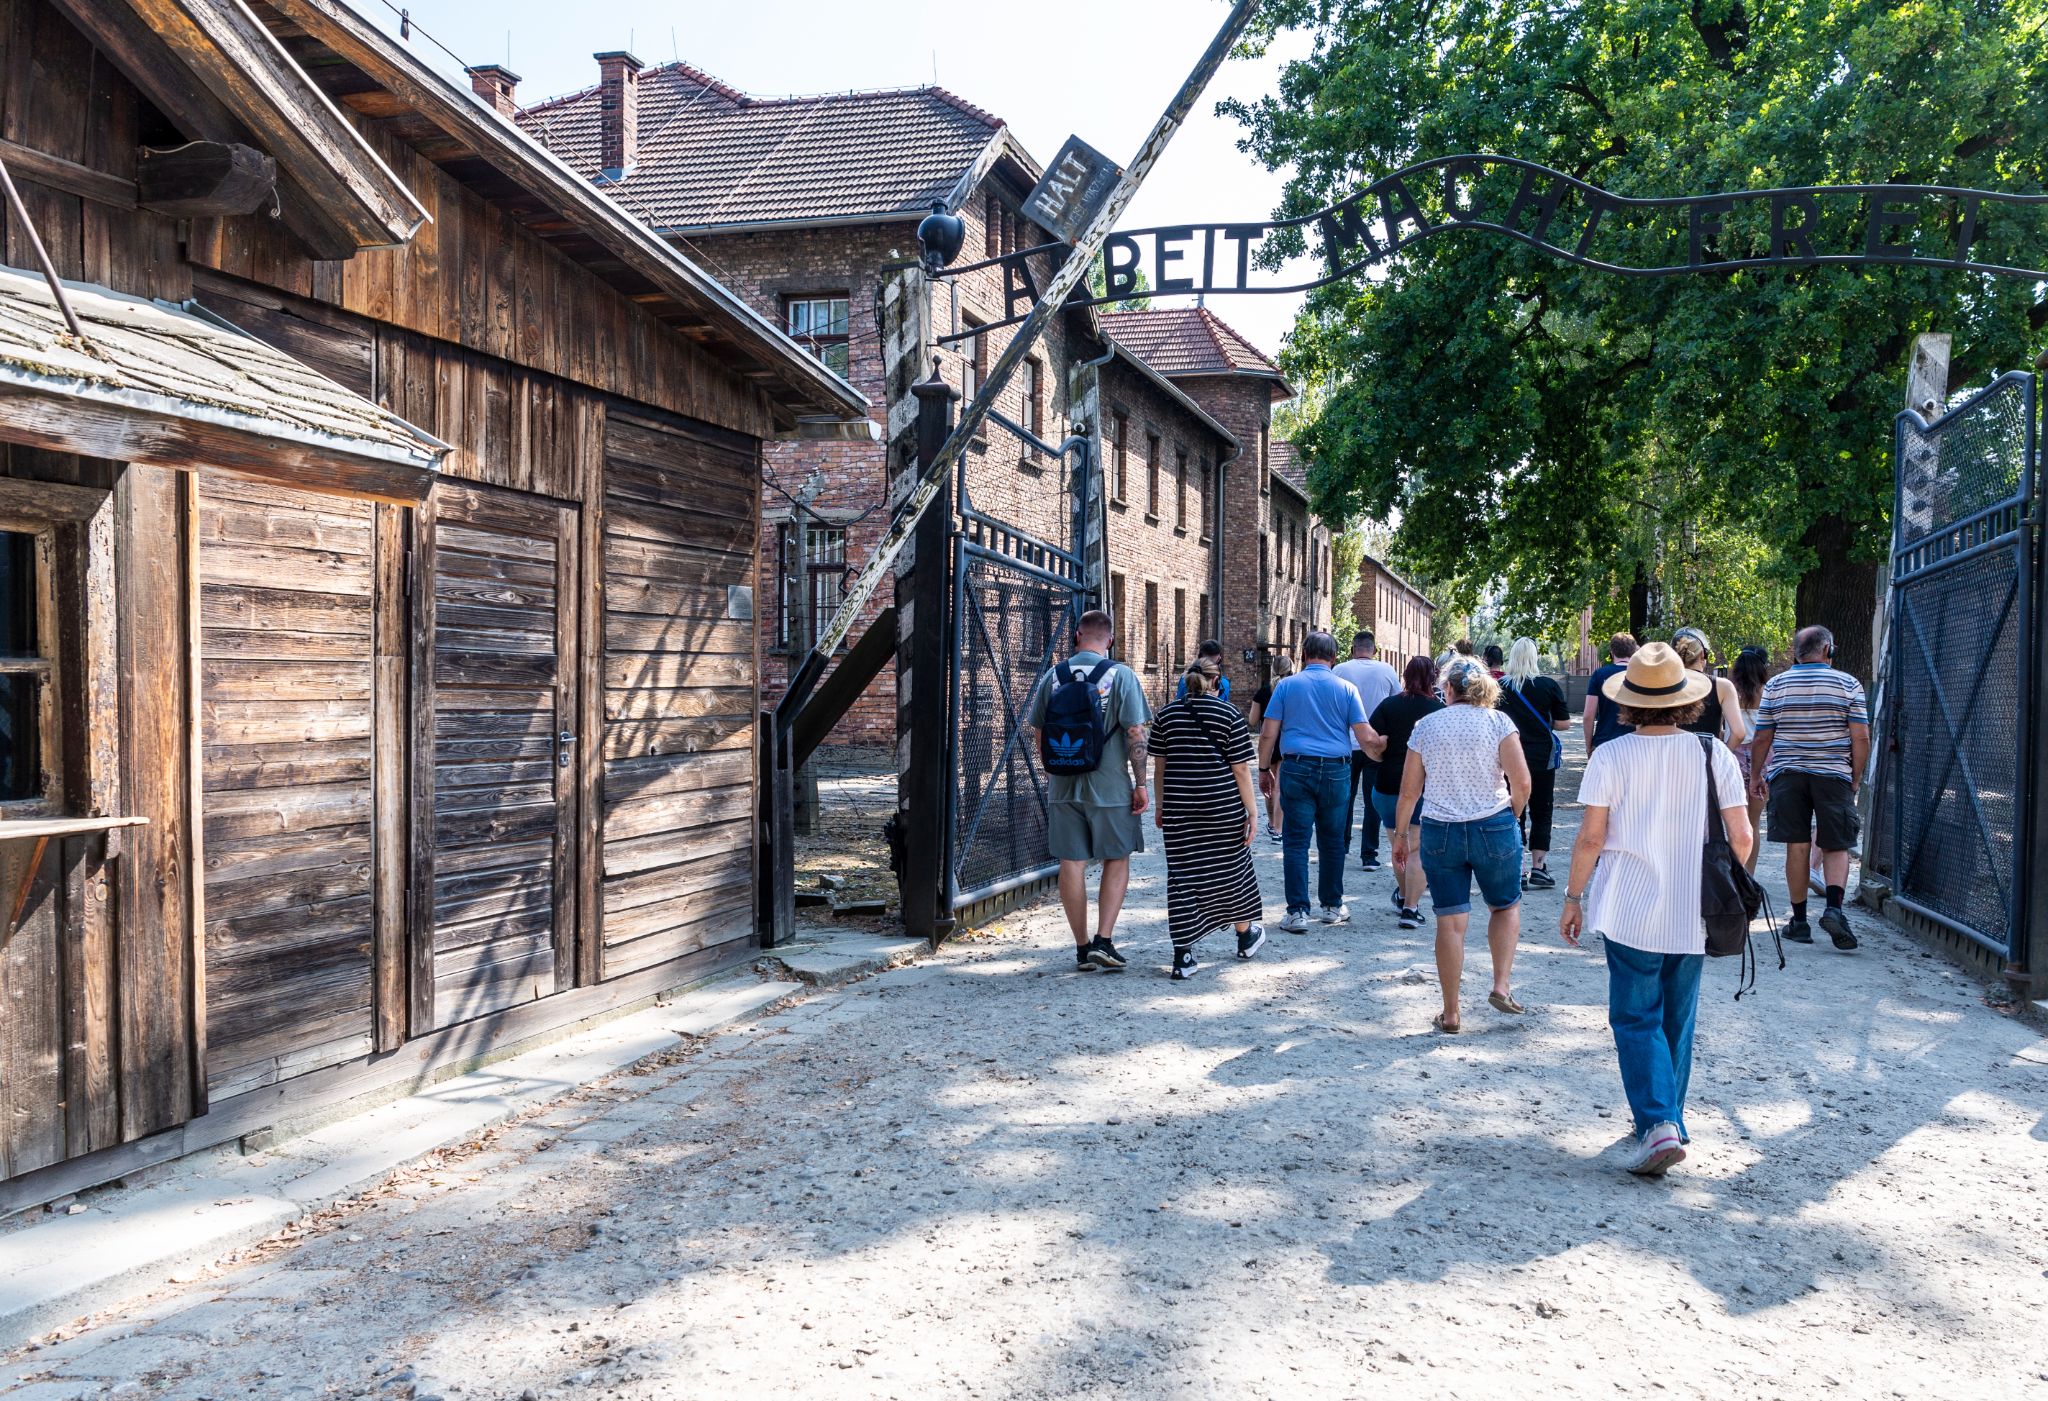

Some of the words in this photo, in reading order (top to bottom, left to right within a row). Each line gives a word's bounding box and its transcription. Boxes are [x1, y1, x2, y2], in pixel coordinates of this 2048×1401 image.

[1034, 151, 1087, 219] HALT
[1321, 161, 1621, 277] MACHT
[1689, 190, 1980, 266] FREI
[1049, 758, 1085, 766] adidas
